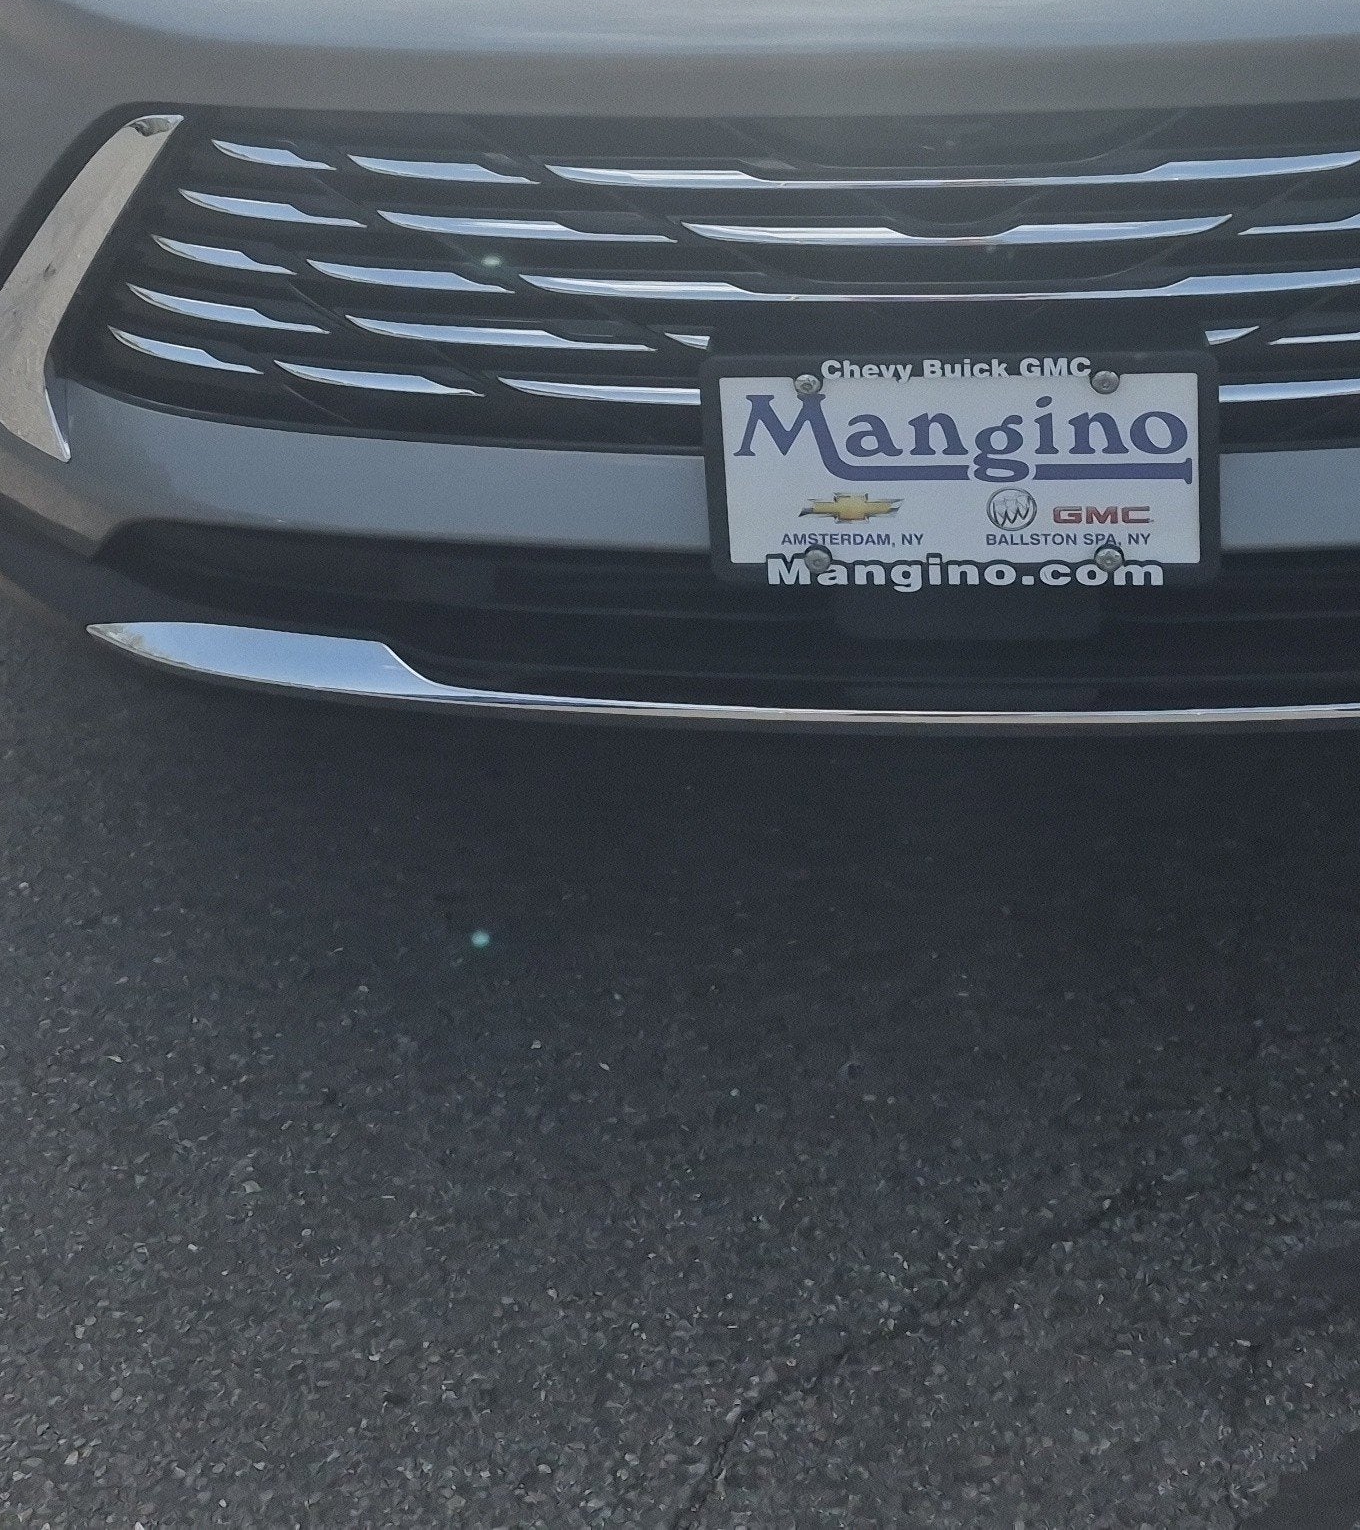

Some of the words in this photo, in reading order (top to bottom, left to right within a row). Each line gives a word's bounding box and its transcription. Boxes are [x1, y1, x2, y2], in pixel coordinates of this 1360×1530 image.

[821, 359, 914, 383] Chevy
[922, 358, 1010, 378] Buick
[1019, 356, 1092, 378] GMC
[733, 394, 1193, 484] Mangino
[1052, 505, 1154, 525] GMC
[780, 532, 897, 549] AMSTERDAM,
[900, 532, 924, 546] NY
[985, 532, 1077, 546] BALLSTON
[1127, 532, 1151, 546] NY
[766, 553, 1165, 593] Mangino.com
